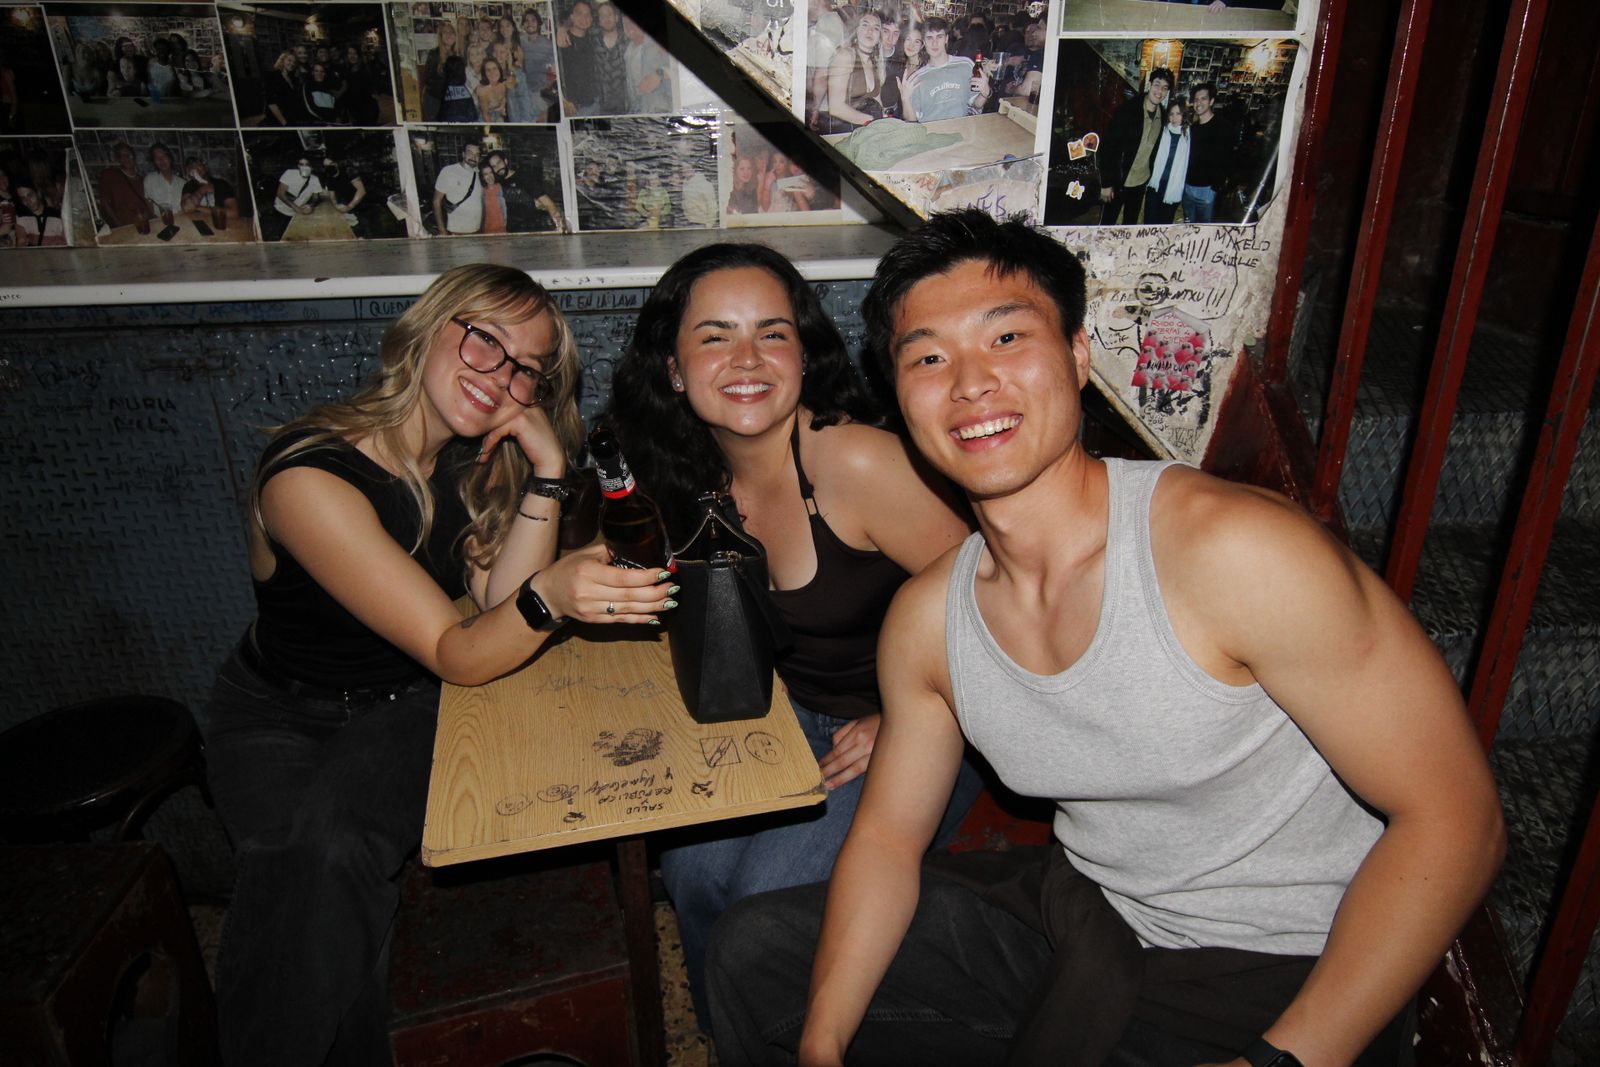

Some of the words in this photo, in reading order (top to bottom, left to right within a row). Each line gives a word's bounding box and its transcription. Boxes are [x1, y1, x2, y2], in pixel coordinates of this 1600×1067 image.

[369, 299, 415, 317] QUEDA
[577, 293, 592, 308] EN
[596, 294, 607, 308] LA
[612, 293, 637, 308] LAVA
[626, 803, 665, 815] SALUD
